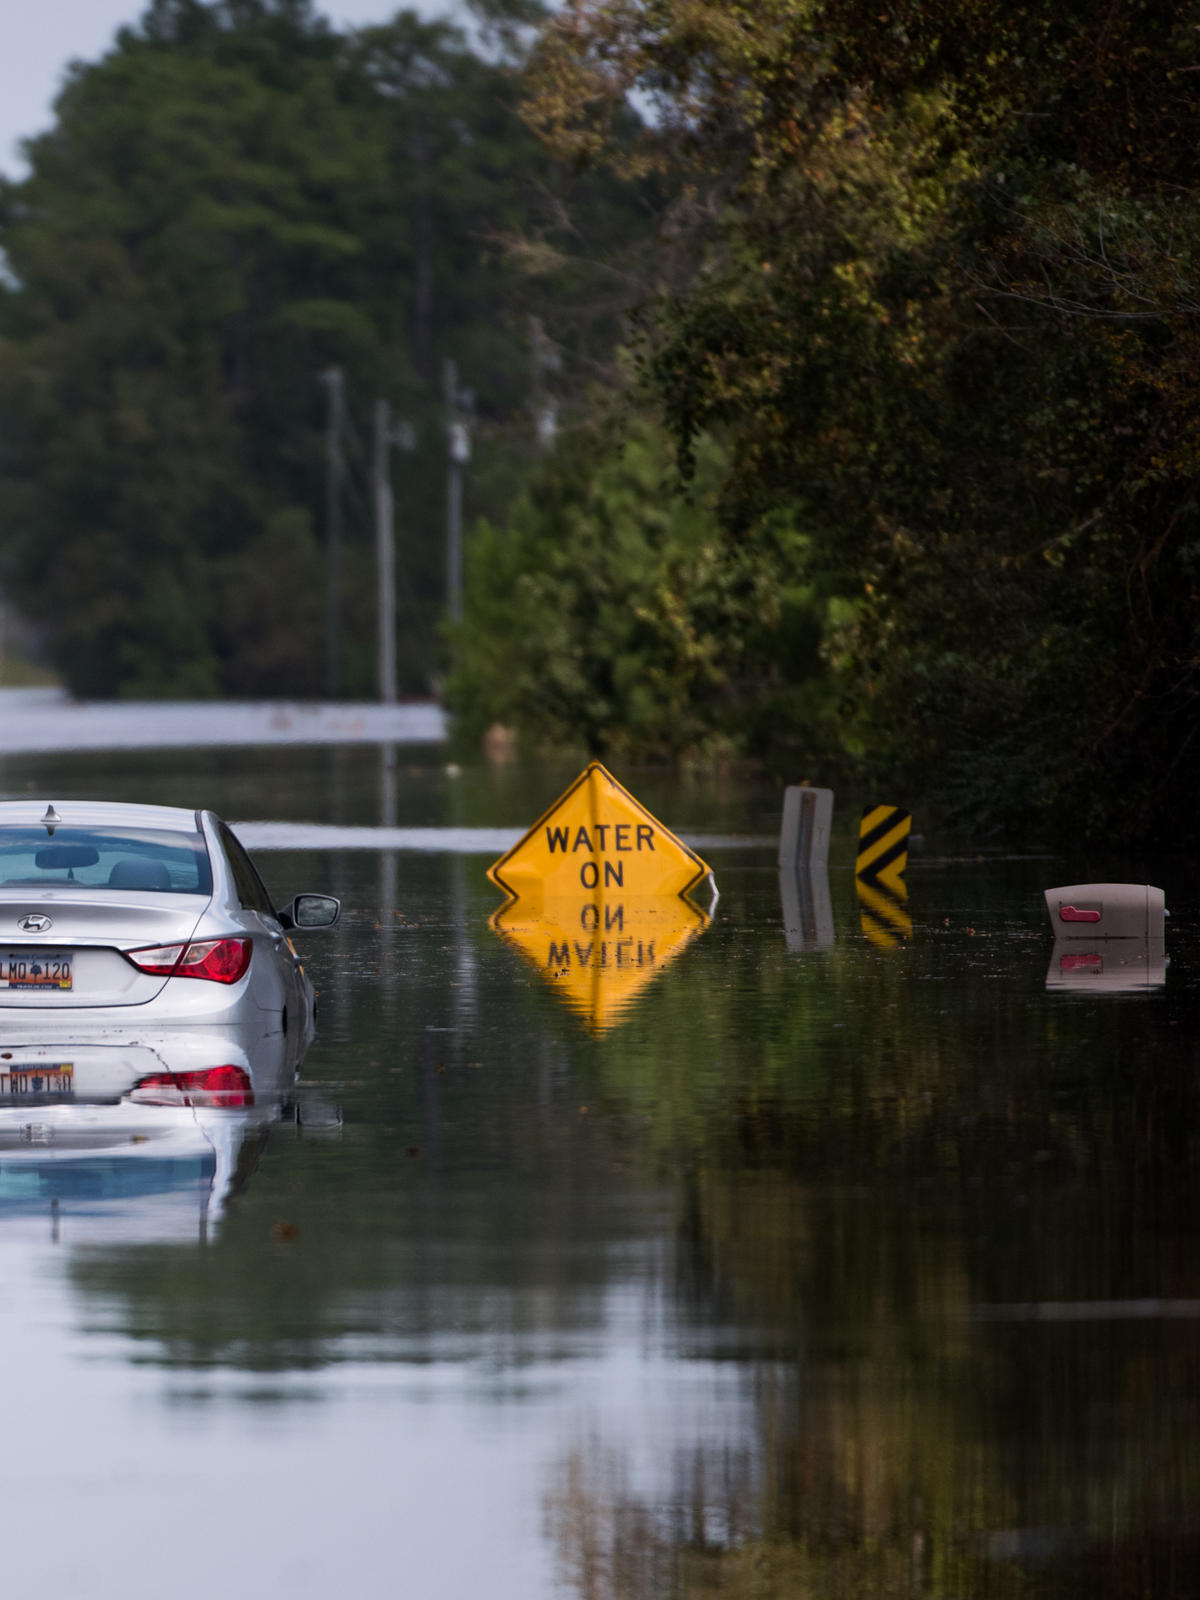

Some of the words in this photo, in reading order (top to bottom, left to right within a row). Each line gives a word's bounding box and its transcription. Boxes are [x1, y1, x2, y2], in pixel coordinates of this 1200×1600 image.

[546, 824, 655, 853] WATER
[580, 861, 623, 889] ON
[43, 962, 70, 980] 120
